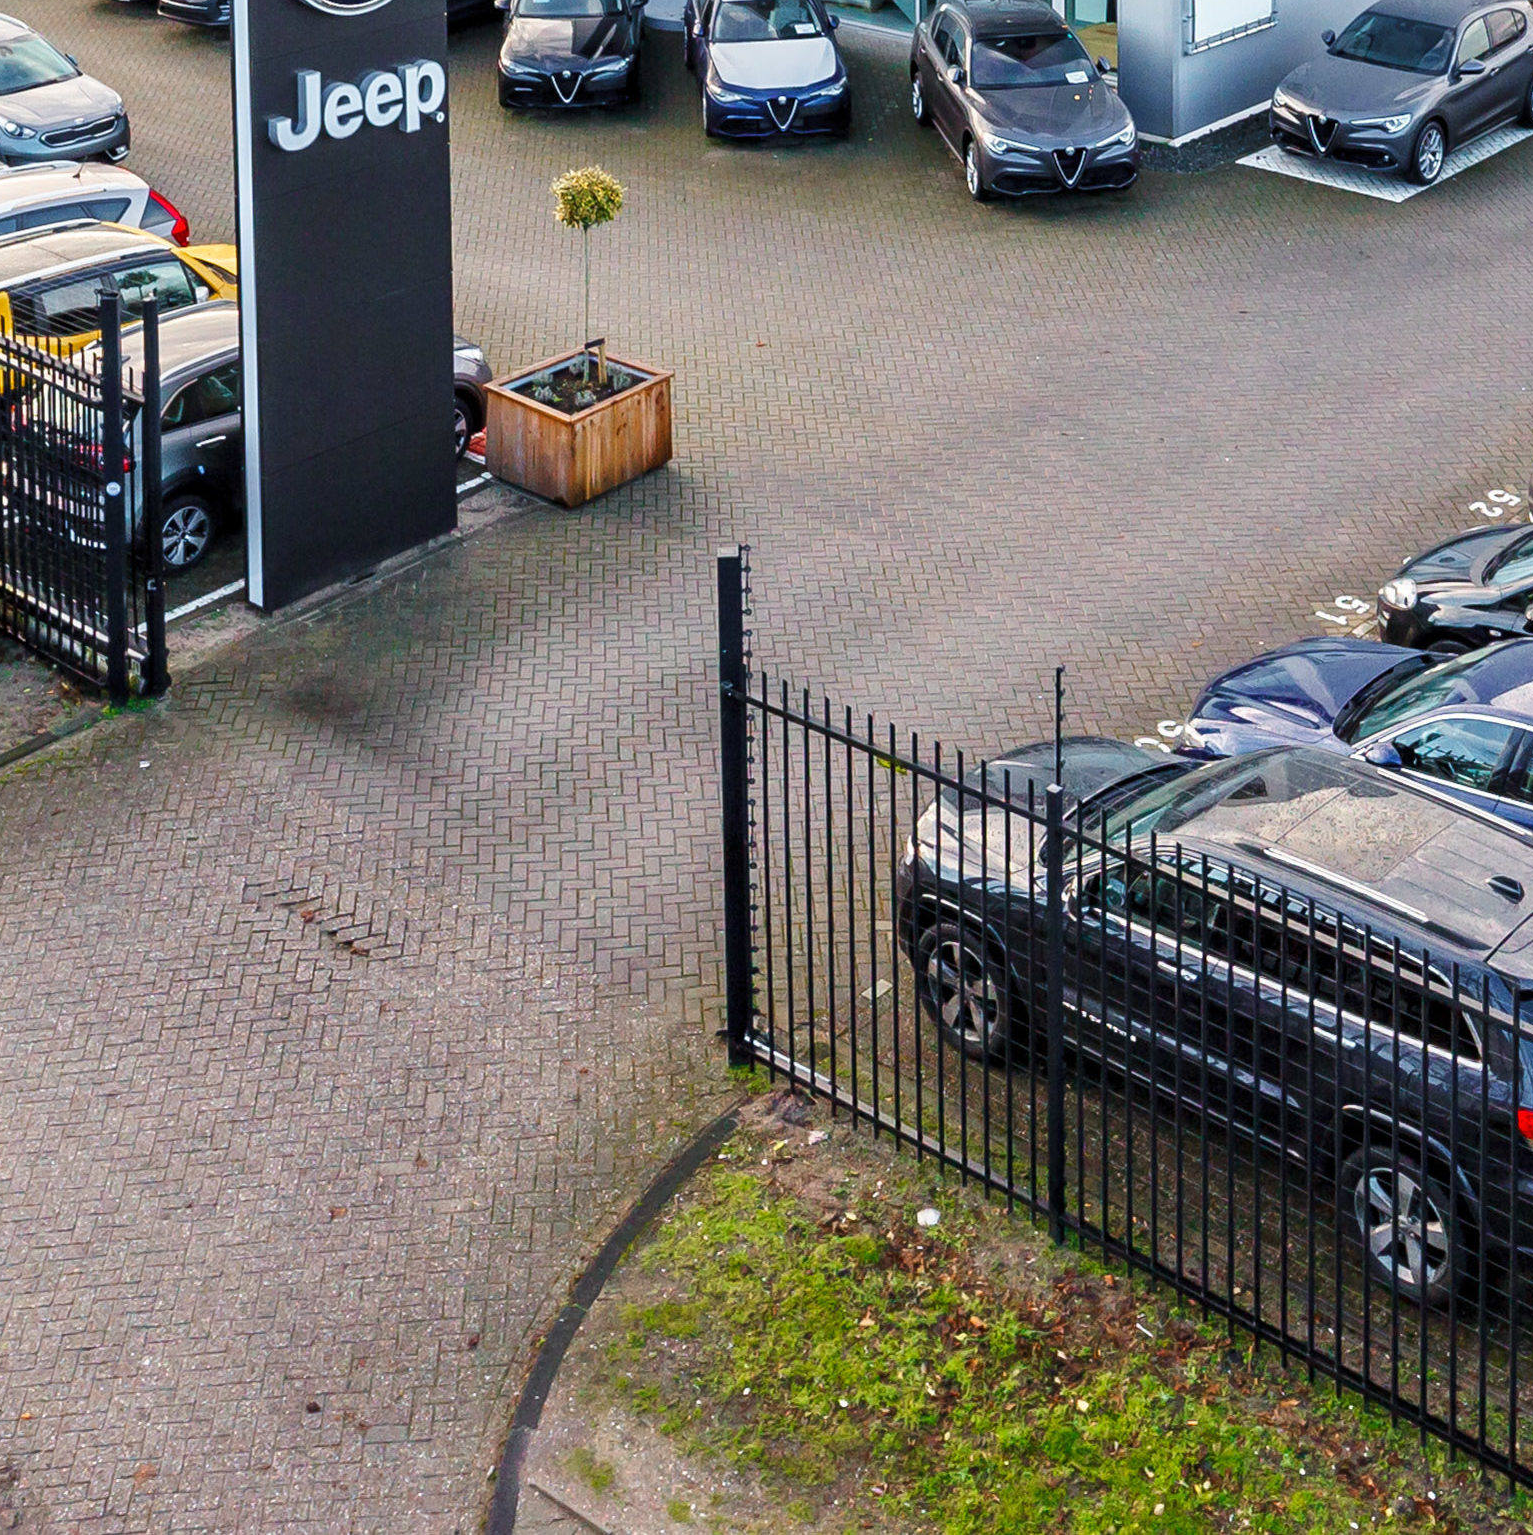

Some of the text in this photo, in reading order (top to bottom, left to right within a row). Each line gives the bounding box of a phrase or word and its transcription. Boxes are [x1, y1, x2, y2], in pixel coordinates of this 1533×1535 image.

[269, 59, 446, 152] Jeep
[1469, 489, 1521, 517] 52
[1315, 595, 1370, 625] 51
